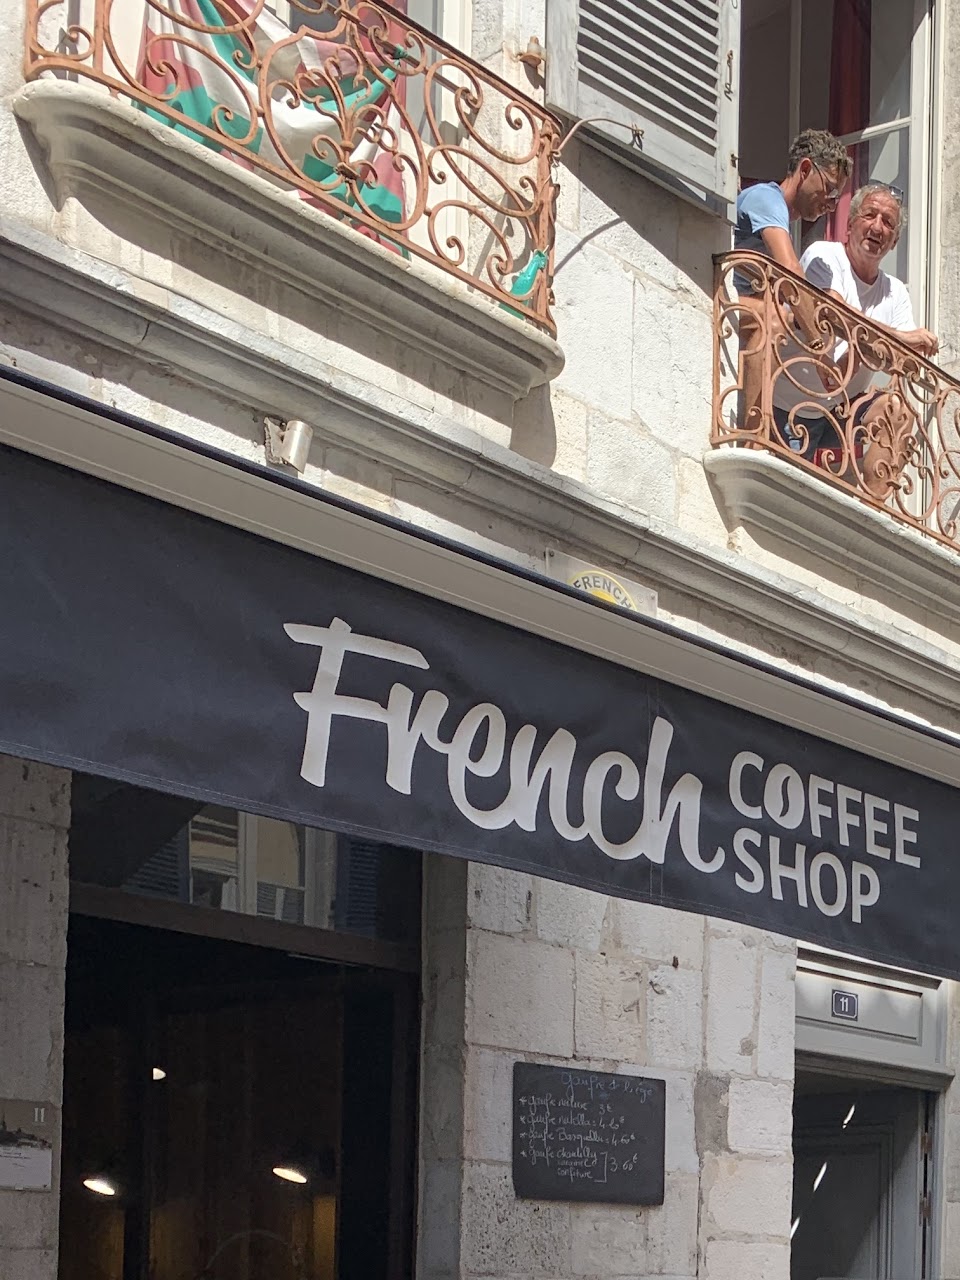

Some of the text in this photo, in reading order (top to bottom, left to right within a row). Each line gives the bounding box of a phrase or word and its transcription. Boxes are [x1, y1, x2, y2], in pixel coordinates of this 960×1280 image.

[283, 616, 724, 874] French
[728, 750, 922, 868] COFFEE
[733, 827, 881, 924] SHOP
[839, 996, 849, 1012] 11
